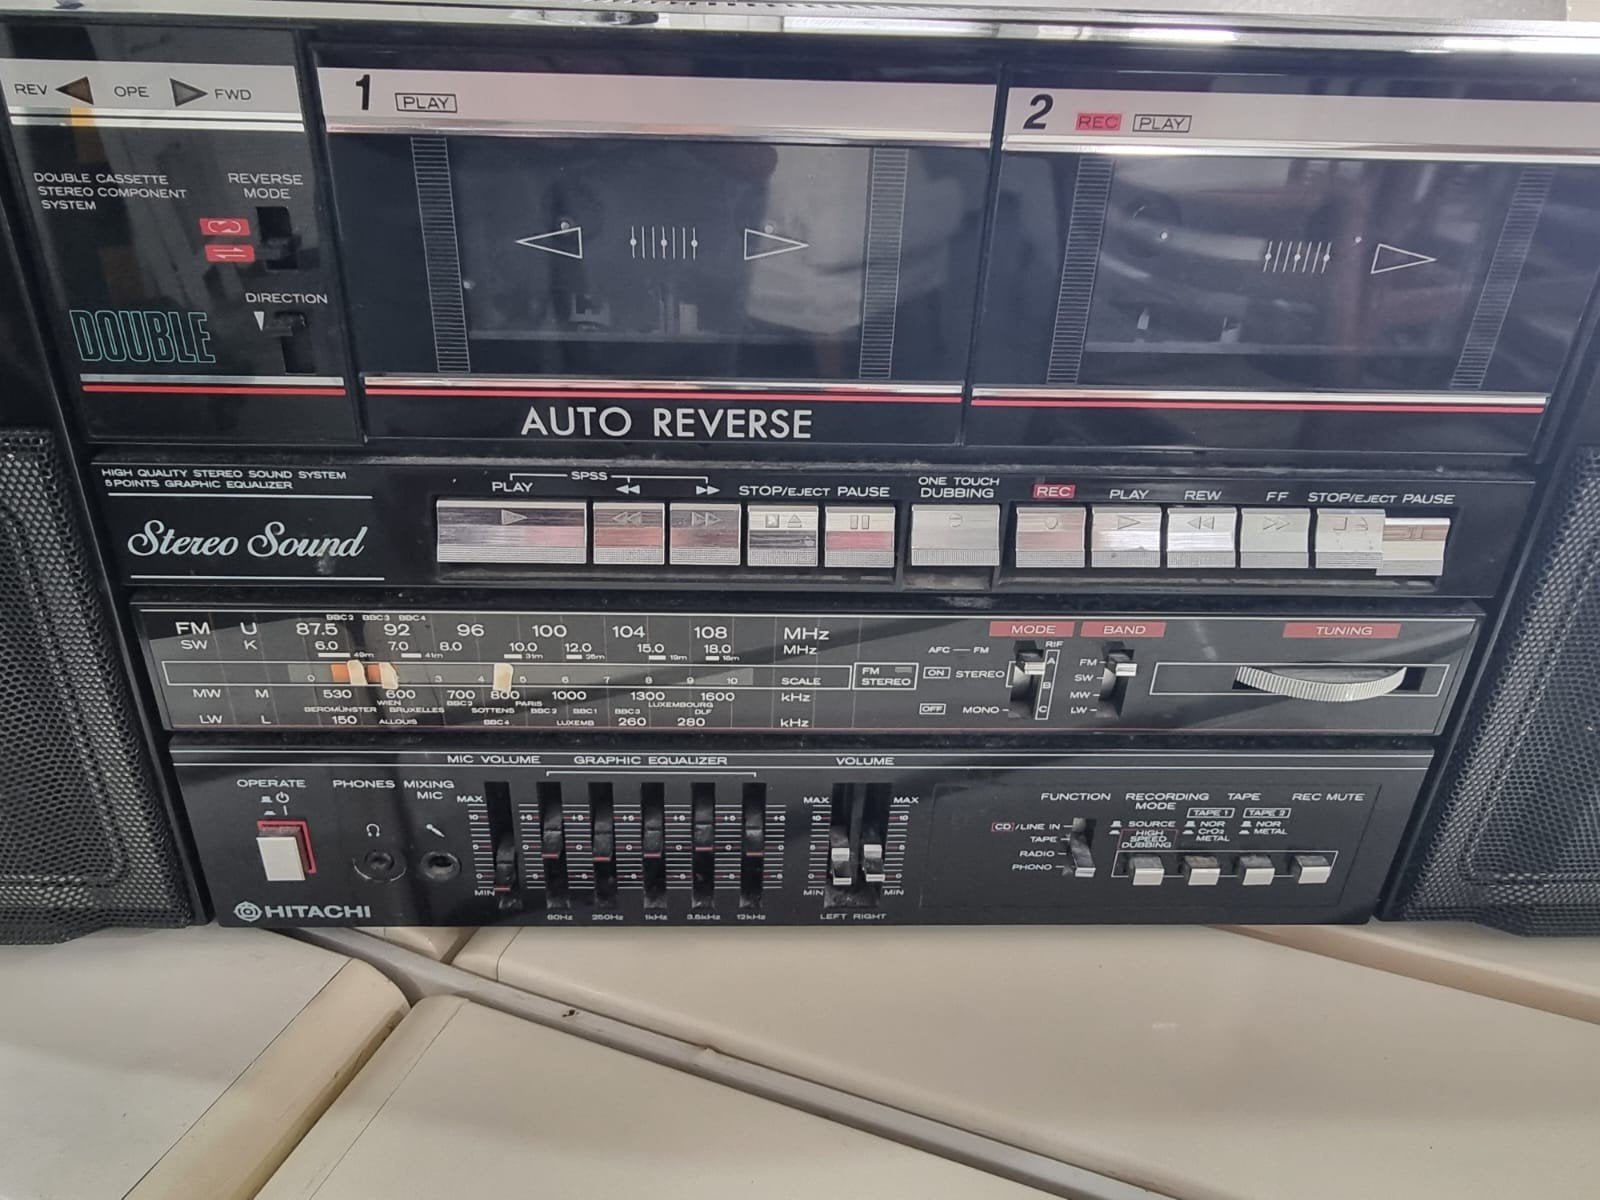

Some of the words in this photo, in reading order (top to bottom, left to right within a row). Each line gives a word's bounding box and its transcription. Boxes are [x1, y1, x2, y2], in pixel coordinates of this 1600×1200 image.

[14, 83, 49, 97] REV
[113, 85, 150, 98] OPE
[214, 88, 252, 101] FWD
[355, 73, 371, 111] 1
[402, 96, 449, 109] PLAY
[1022, 93, 1054, 130] 2
[1078, 115, 1119, 129] REC
[1138, 116, 1186, 131] PLAY
[33, 172, 90, 184] DOUBLE
[95, 173, 169, 185] CASSETTE
[227, 172, 304, 186] REVERSE
[37, 186, 94, 198] STEREO
[97, 187, 187, 199] COMPONENT
[243, 187, 291, 200] MODE
[41, 199, 97, 211] SYSTEM
[245, 292, 329, 305] DIRECTION
[69, 309, 216, 364] DOUBLE
[520, 405, 633, 437] AUTO
[653, 407, 813, 439] REVERSE
[101, 468, 133, 478] HIGH
[137, 468, 188, 479] QUALITY
[192, 469, 243, 479] STEREO
[247, 469, 293, 480] SOUND
[298, 470, 347, 480] SYSTEM
[570, 470, 608, 481] SPSS
[164, 479, 222, 489] GRAPHIC
[225, 480, 293, 490] EQUALIZER
[917, 476, 948, 486] ONE
[953, 476, 1000, 487] TOUCH
[491, 481, 534, 493] PLAY
[738, 485, 831, 498] STOP/EJECT
[837, 486, 891, 498] PAUSE
[1036, 485, 1073, 498] REC
[919, 487, 995, 499] DUBBING
[1108, 488, 1151, 501] PLAY
[1183, 489, 1222, 501] REW
[1265, 490, 1289, 502] FF
[1307, 491, 1398, 505] STOP/EJECT
[1401, 493, 1456, 505] PAUSE
[127, 519, 239, 558] Stereo
[246, 520, 369, 558] Sound
[175, 621, 211, 636] FM
[239, 621, 258, 635] U
[295, 622, 339, 636] 87.5
[383, 623, 411, 637] 92
[456, 623, 485, 637] 96
[531, 624, 568, 638] 100
[611, 625, 646, 639] 104
[693, 626, 728, 639] 108
[783, 627, 830, 641] MHz
[1010, 624, 1057, 634] MODE
[1103, 625, 1146, 635] BAND
[1315, 626, 1374, 636] TUNING
[180, 639, 208, 650] SW
[243, 639, 258, 650] K
[314, 640, 339, 651] 6.0
[387, 641, 409, 651] 7.0
[439, 641, 463, 651] 8.0
[509, 642, 538, 652] 10.0
[564, 642, 592, 653] 12.0
[636, 643, 665, 653] 15.0
[703, 644, 732, 654] 18.0
[783, 645, 817, 656] MHz
[927, 646, 951, 654] AFC
[972, 646, 990, 654] FM
[1046, 657, 1056, 665] A
[1079, 658, 1098, 667] FM
[861, 667, 880, 675] FM
[927, 669, 945, 677] ON
[955, 670, 1005, 679] STEREO
[780, 677, 822, 686] SCALE
[861, 677, 912, 686] STEREO
[1073, 674, 1094, 682] SW
[192, 688, 222, 699] MW
[254, 689, 270, 699] M
[322, 689, 352, 699] 530
[385, 689, 416, 699] 600
[446, 690, 476, 700] 700
[551, 690, 587, 700] 1000
[629, 691, 666, 701] 1300
[700, 692, 735, 702] 1600
[780, 692, 811, 702] kHz
[1069, 691, 1091, 699] MW
[648, 701, 714, 709] LUXEMBOURG
[921, 705, 944, 713] OFF
[1070, 706, 1088, 714] LW
[962, 706, 1000, 715] MONO
[199, 714, 223, 724] LW
[260, 715, 272, 725] L
[331, 715, 358, 725] 150
[618, 717, 647, 727] 260
[676, 717, 706, 727] 280
[780, 718, 810, 728] kHz
[446, 754, 475, 764] MIC
[480, 755, 542, 765] VOLUME
[573, 755, 642, 765] GRAPHIC
[648, 756, 728, 766] EQUALIZER
[835, 756, 896, 766] VOLUME
[236, 779, 307, 789] OPERATE
[332, 779, 396, 789] PHONES
[403, 779, 455, 789] MIXING
[416, 791, 444, 800] MIC
[456, 795, 484, 803] MAX
[803, 796, 830, 804] MAX
[893, 796, 920, 804] MAX
[1040, 792, 1112, 801] FUNCTION
[1125, 792, 1210, 801] RECORDING
[1227, 792, 1262, 801] TAPE
[1292, 792, 1322, 802] REC
[1326, 793, 1365, 802] MUTE
[1135, 802, 1177, 811] MODE
[1048, 823, 1061, 831] IN
[1128, 820, 1176, 828] SOURCE
[1199, 820, 1226, 828] NOR
[1135, 829, 1164, 837] HIGH
[1129, 835, 1167, 843] SPEED
[1121, 841, 1172, 849] DUBBING
[1019, 850, 1055, 858] RADIO
[1011, 863, 1053, 871] PHONO
[474, 889, 496, 897] MIN
[264, 905, 371, 919] HITACHI
